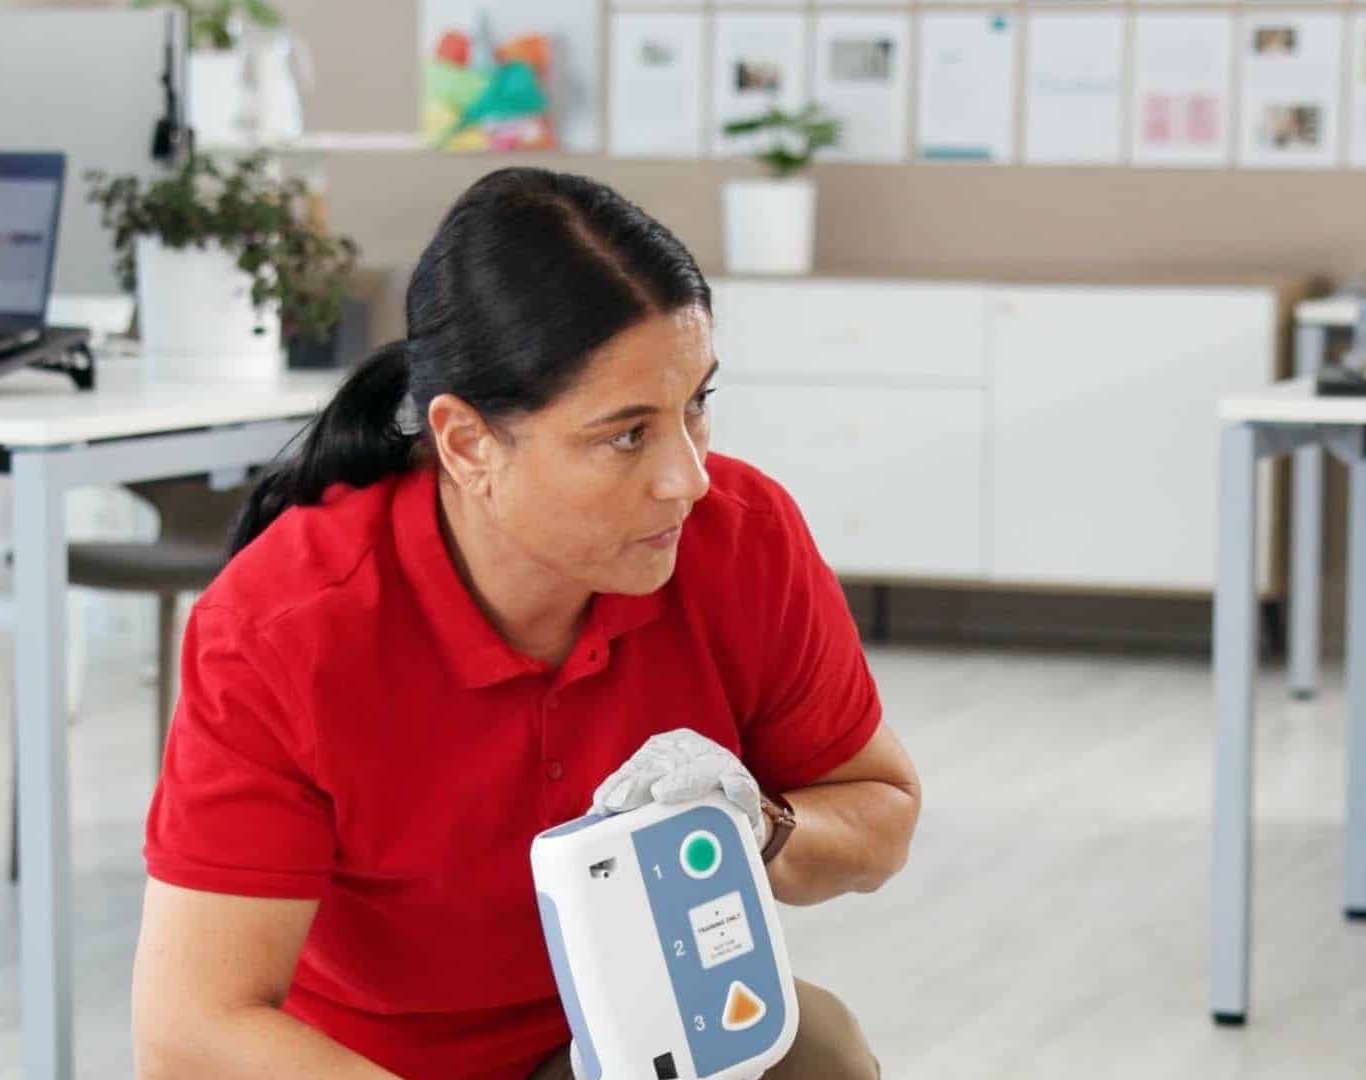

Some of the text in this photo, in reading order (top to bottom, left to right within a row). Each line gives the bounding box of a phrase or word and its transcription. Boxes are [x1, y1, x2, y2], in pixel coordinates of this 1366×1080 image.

[653, 864, 663, 880] 1
[673, 940, 685, 957] 2
[694, 1015, 705, 1031] 3
